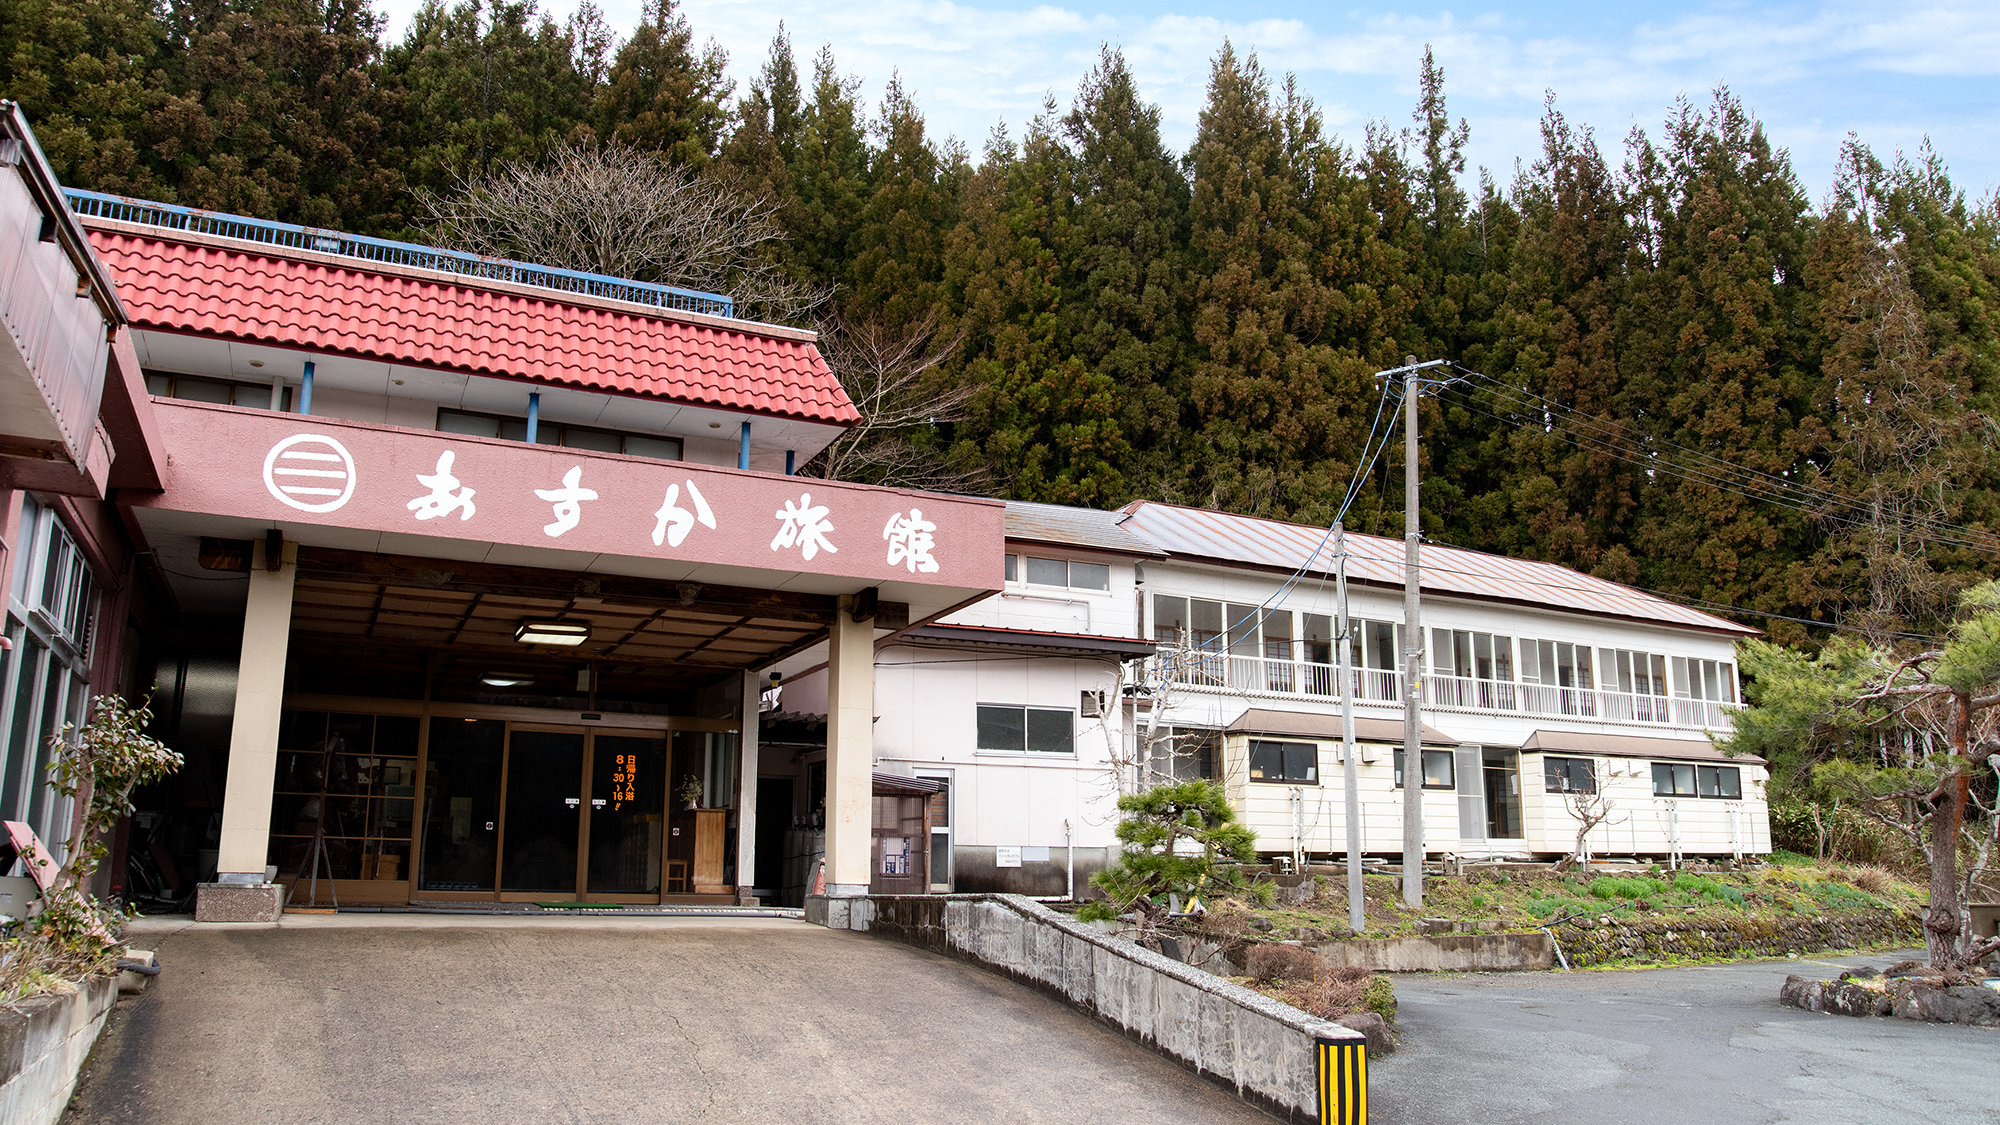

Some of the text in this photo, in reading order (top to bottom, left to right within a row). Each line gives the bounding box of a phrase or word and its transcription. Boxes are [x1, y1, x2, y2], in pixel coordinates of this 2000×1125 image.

[406, 449, 940, 574] あすか旅館
[625, 754, 637, 801] 日帰り入浴
